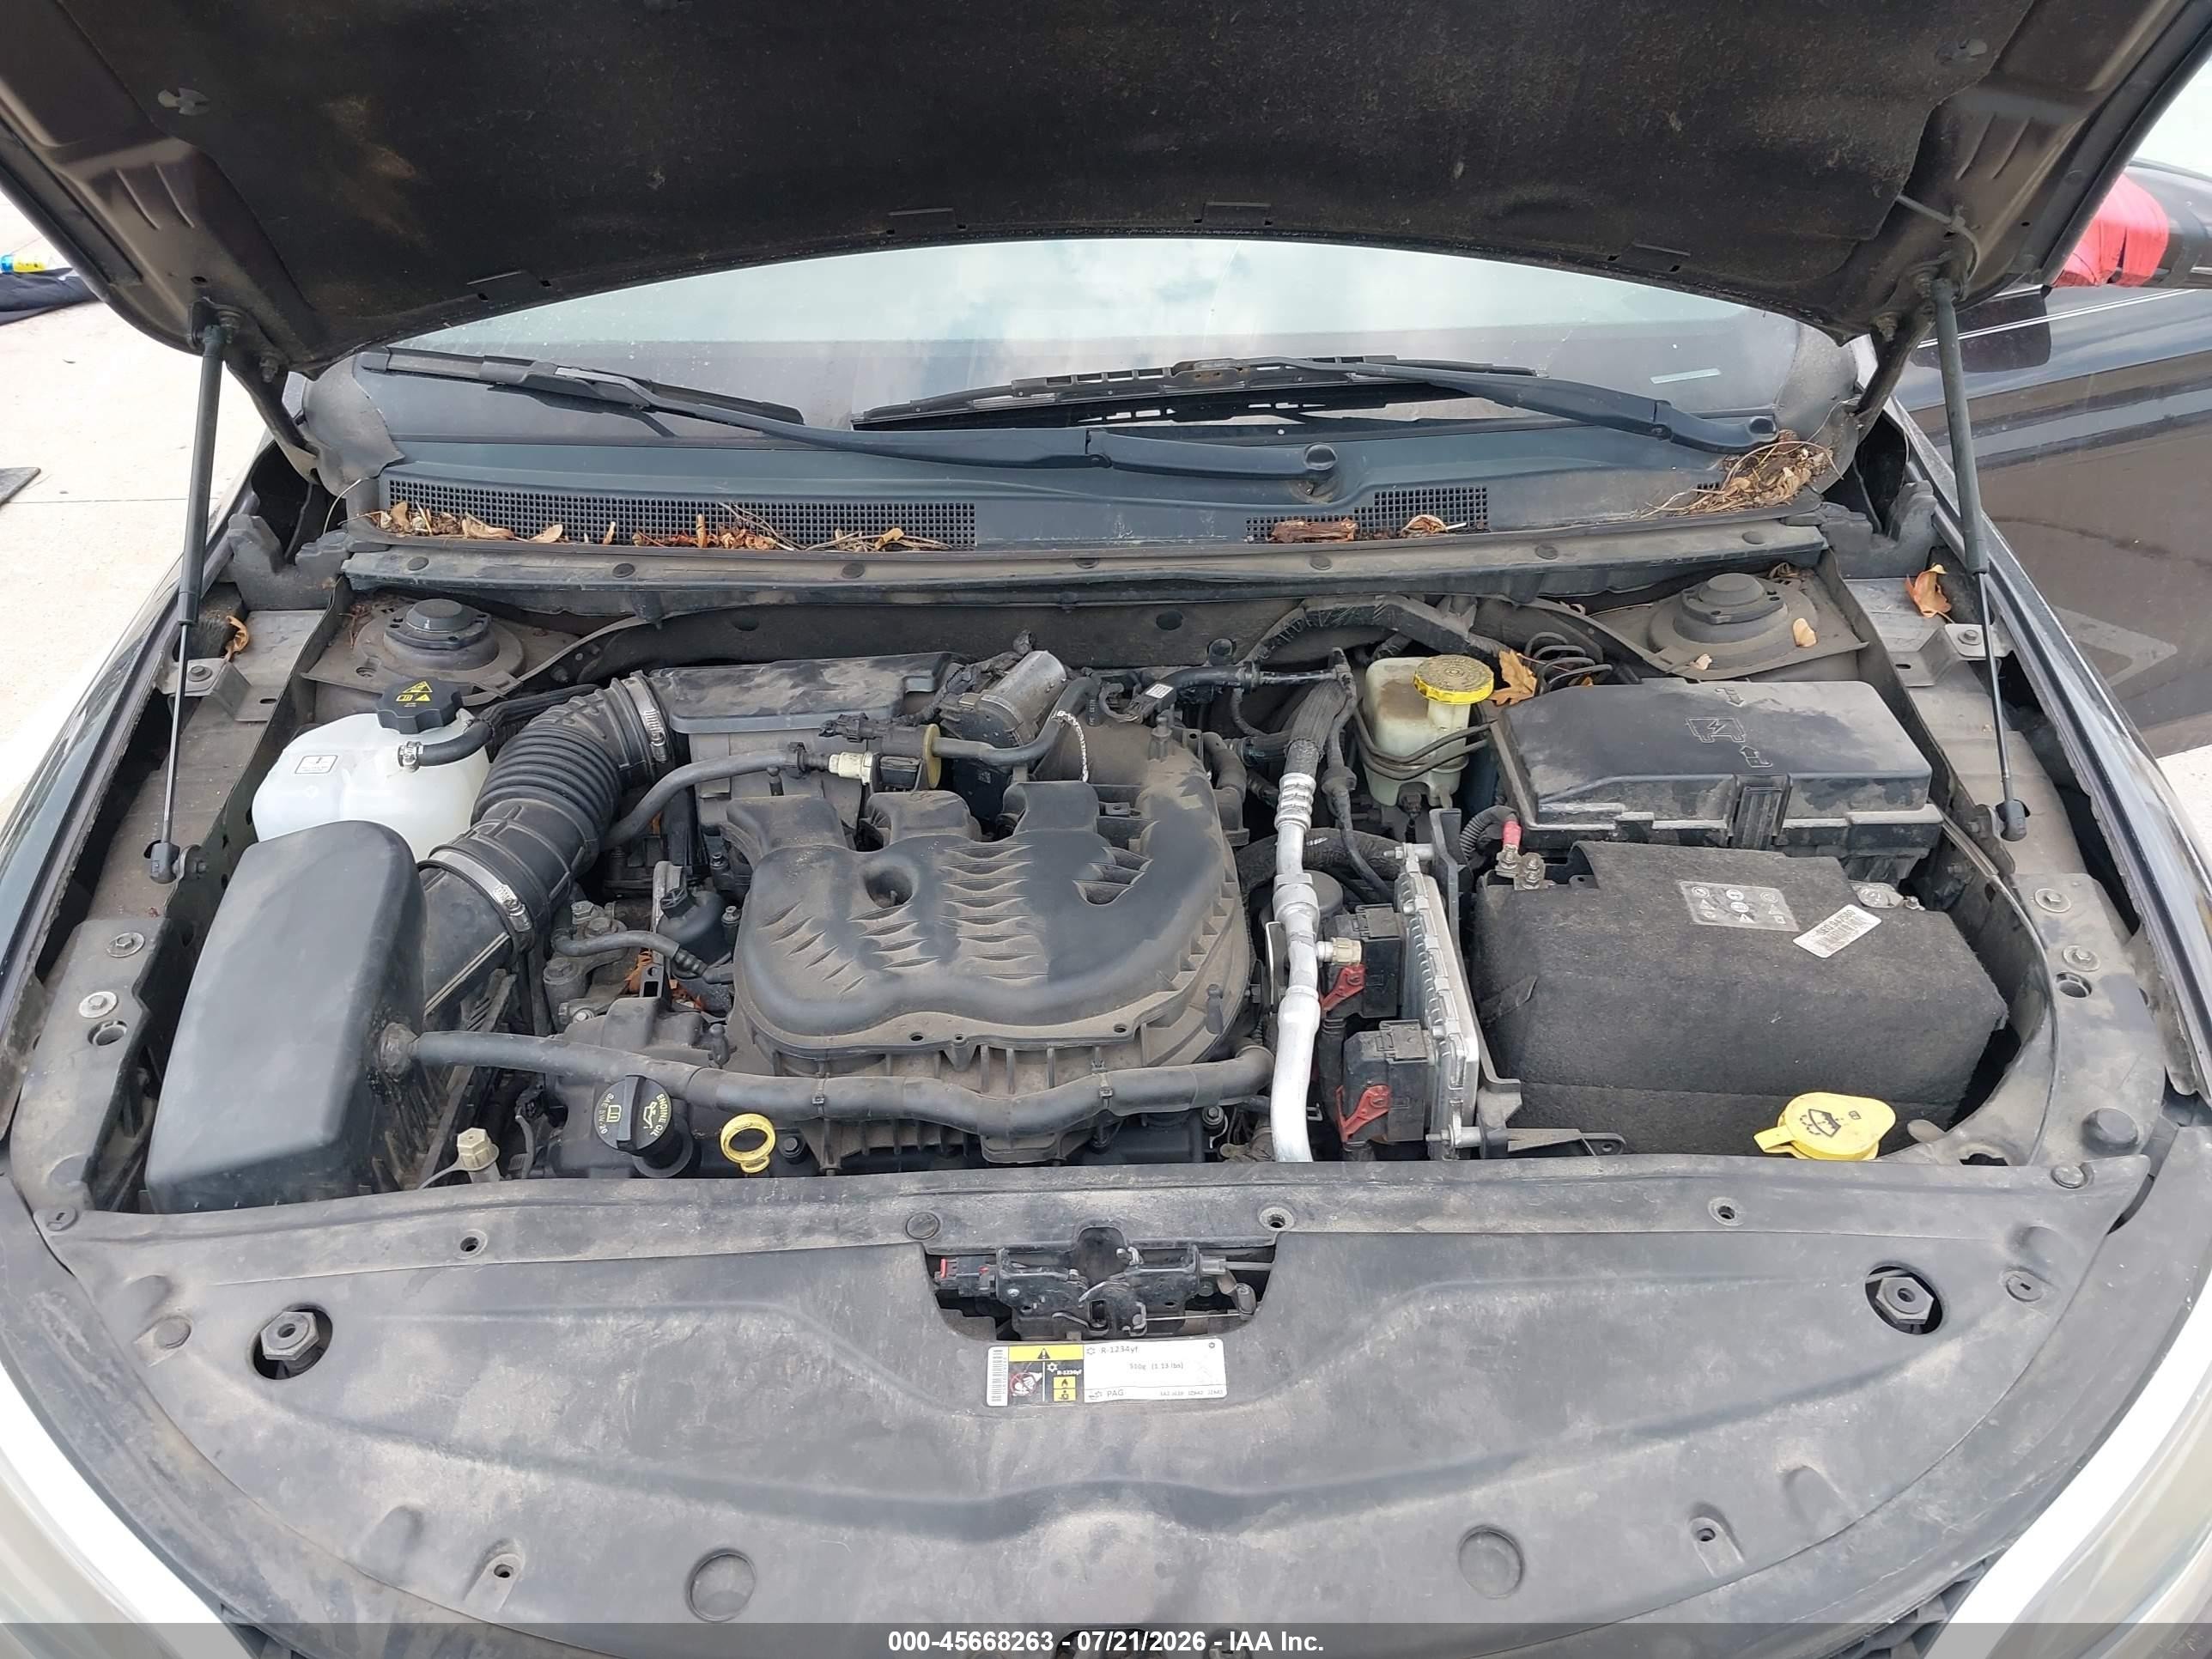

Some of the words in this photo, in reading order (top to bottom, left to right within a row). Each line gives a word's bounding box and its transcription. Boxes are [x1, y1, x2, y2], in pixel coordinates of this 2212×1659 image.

[601, 1092, 615, 1108] SAE
[656, 1093, 668, 1123] ENGINE
[650, 1124, 664, 1137] OIL
[1107, 1389, 1124, 1398] PAG
